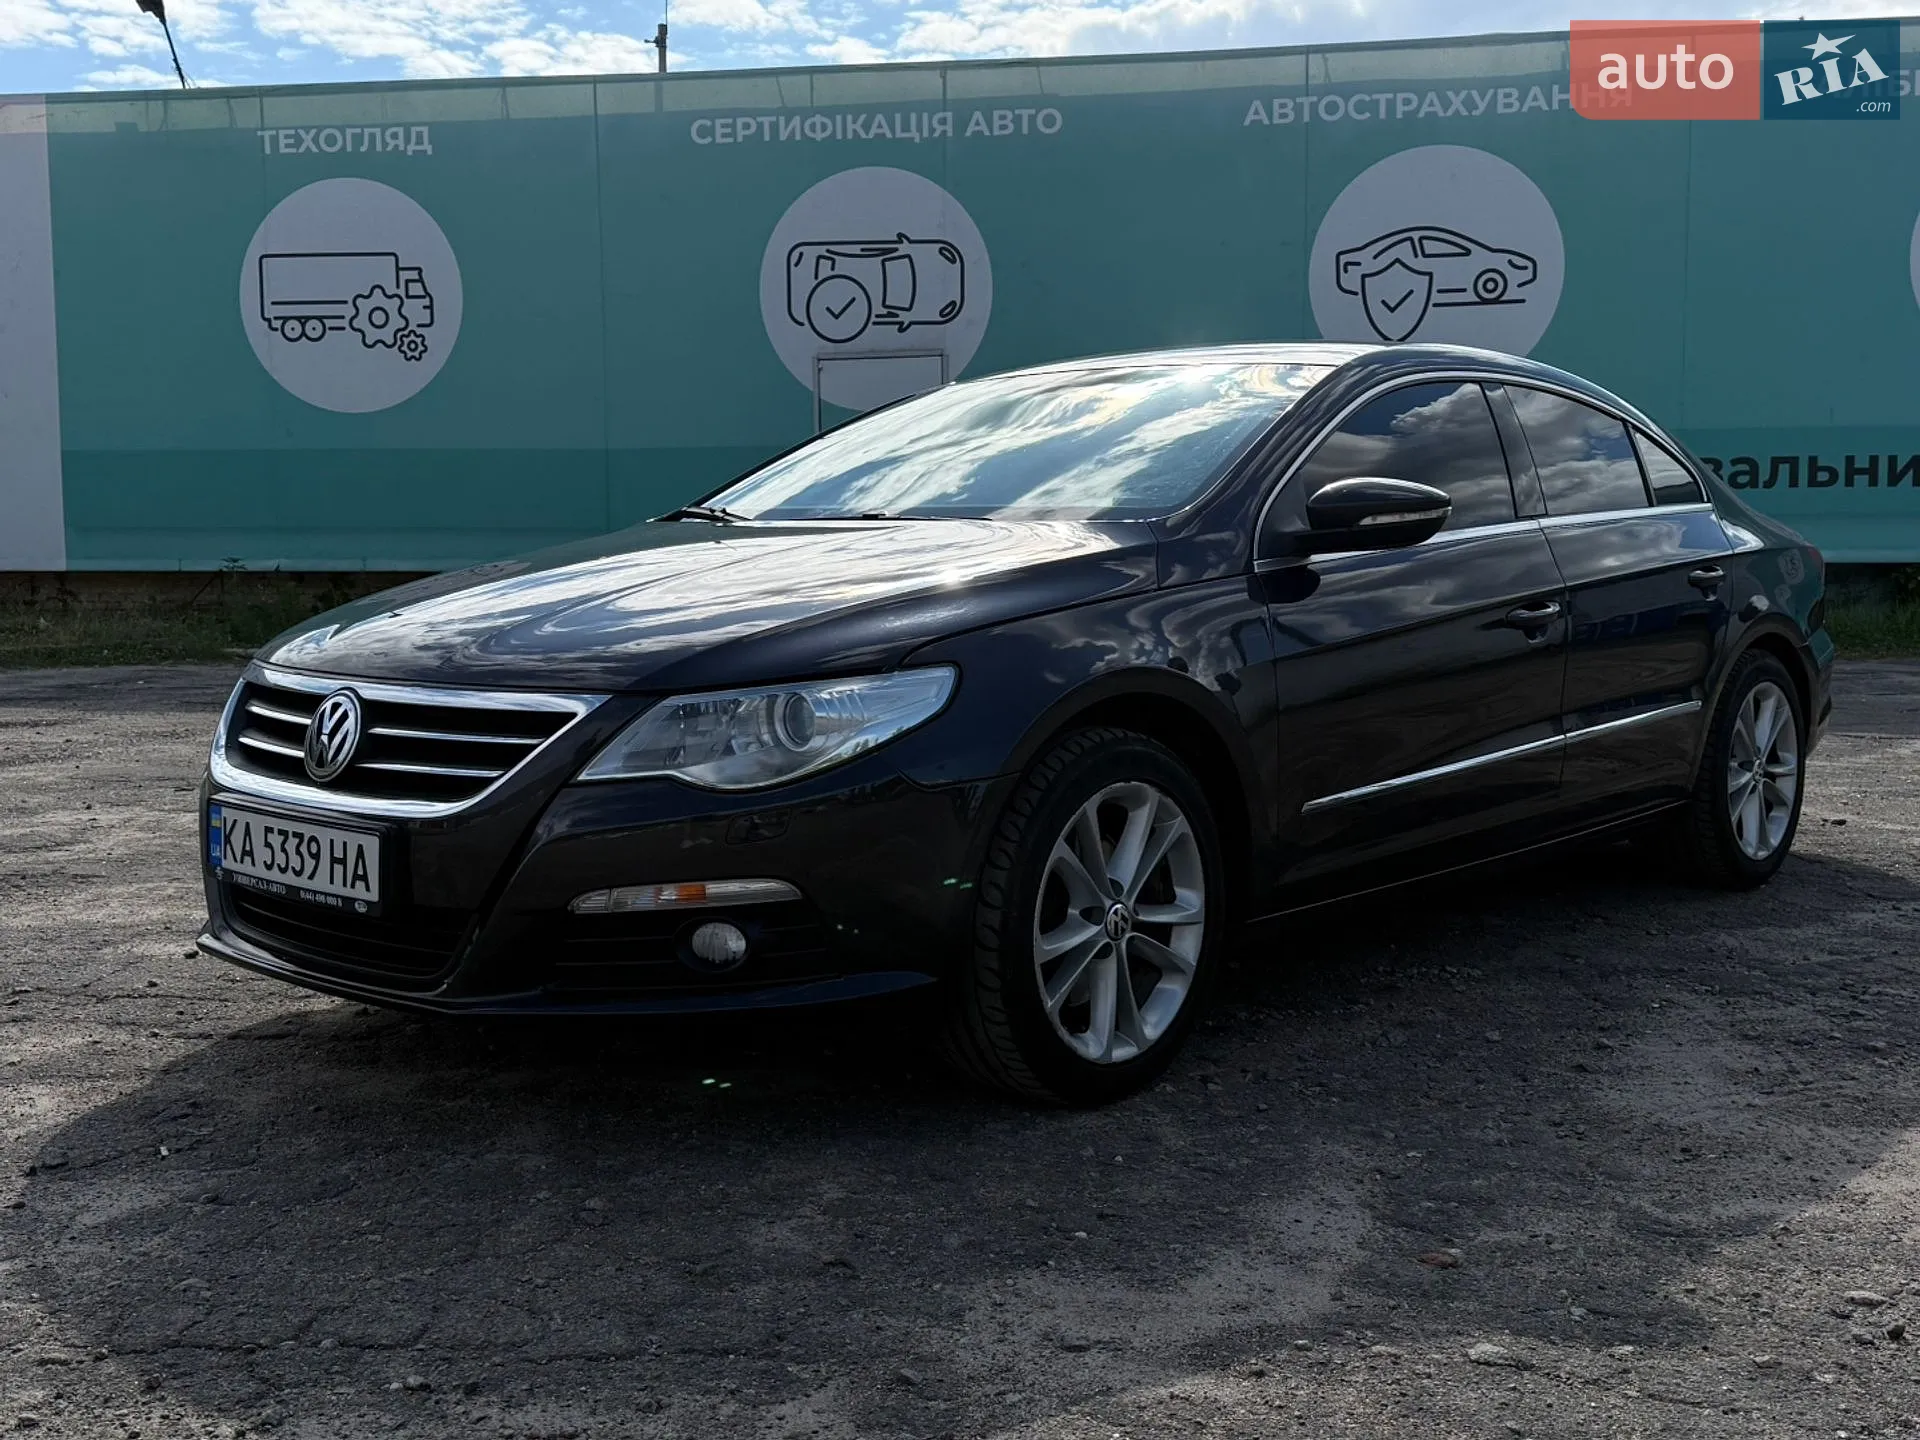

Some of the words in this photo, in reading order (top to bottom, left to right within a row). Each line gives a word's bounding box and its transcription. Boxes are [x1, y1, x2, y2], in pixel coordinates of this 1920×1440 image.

[257, 126, 433, 155] ТЕХОГЛЯД
[690, 111, 954, 144] СЕРТИФІКАЦІЯ
[965, 108, 1063, 137] АВТО
[223, 816, 256, 867] KA
[263, 825, 321, 880] 5339
[329, 839, 371, 892] HA
